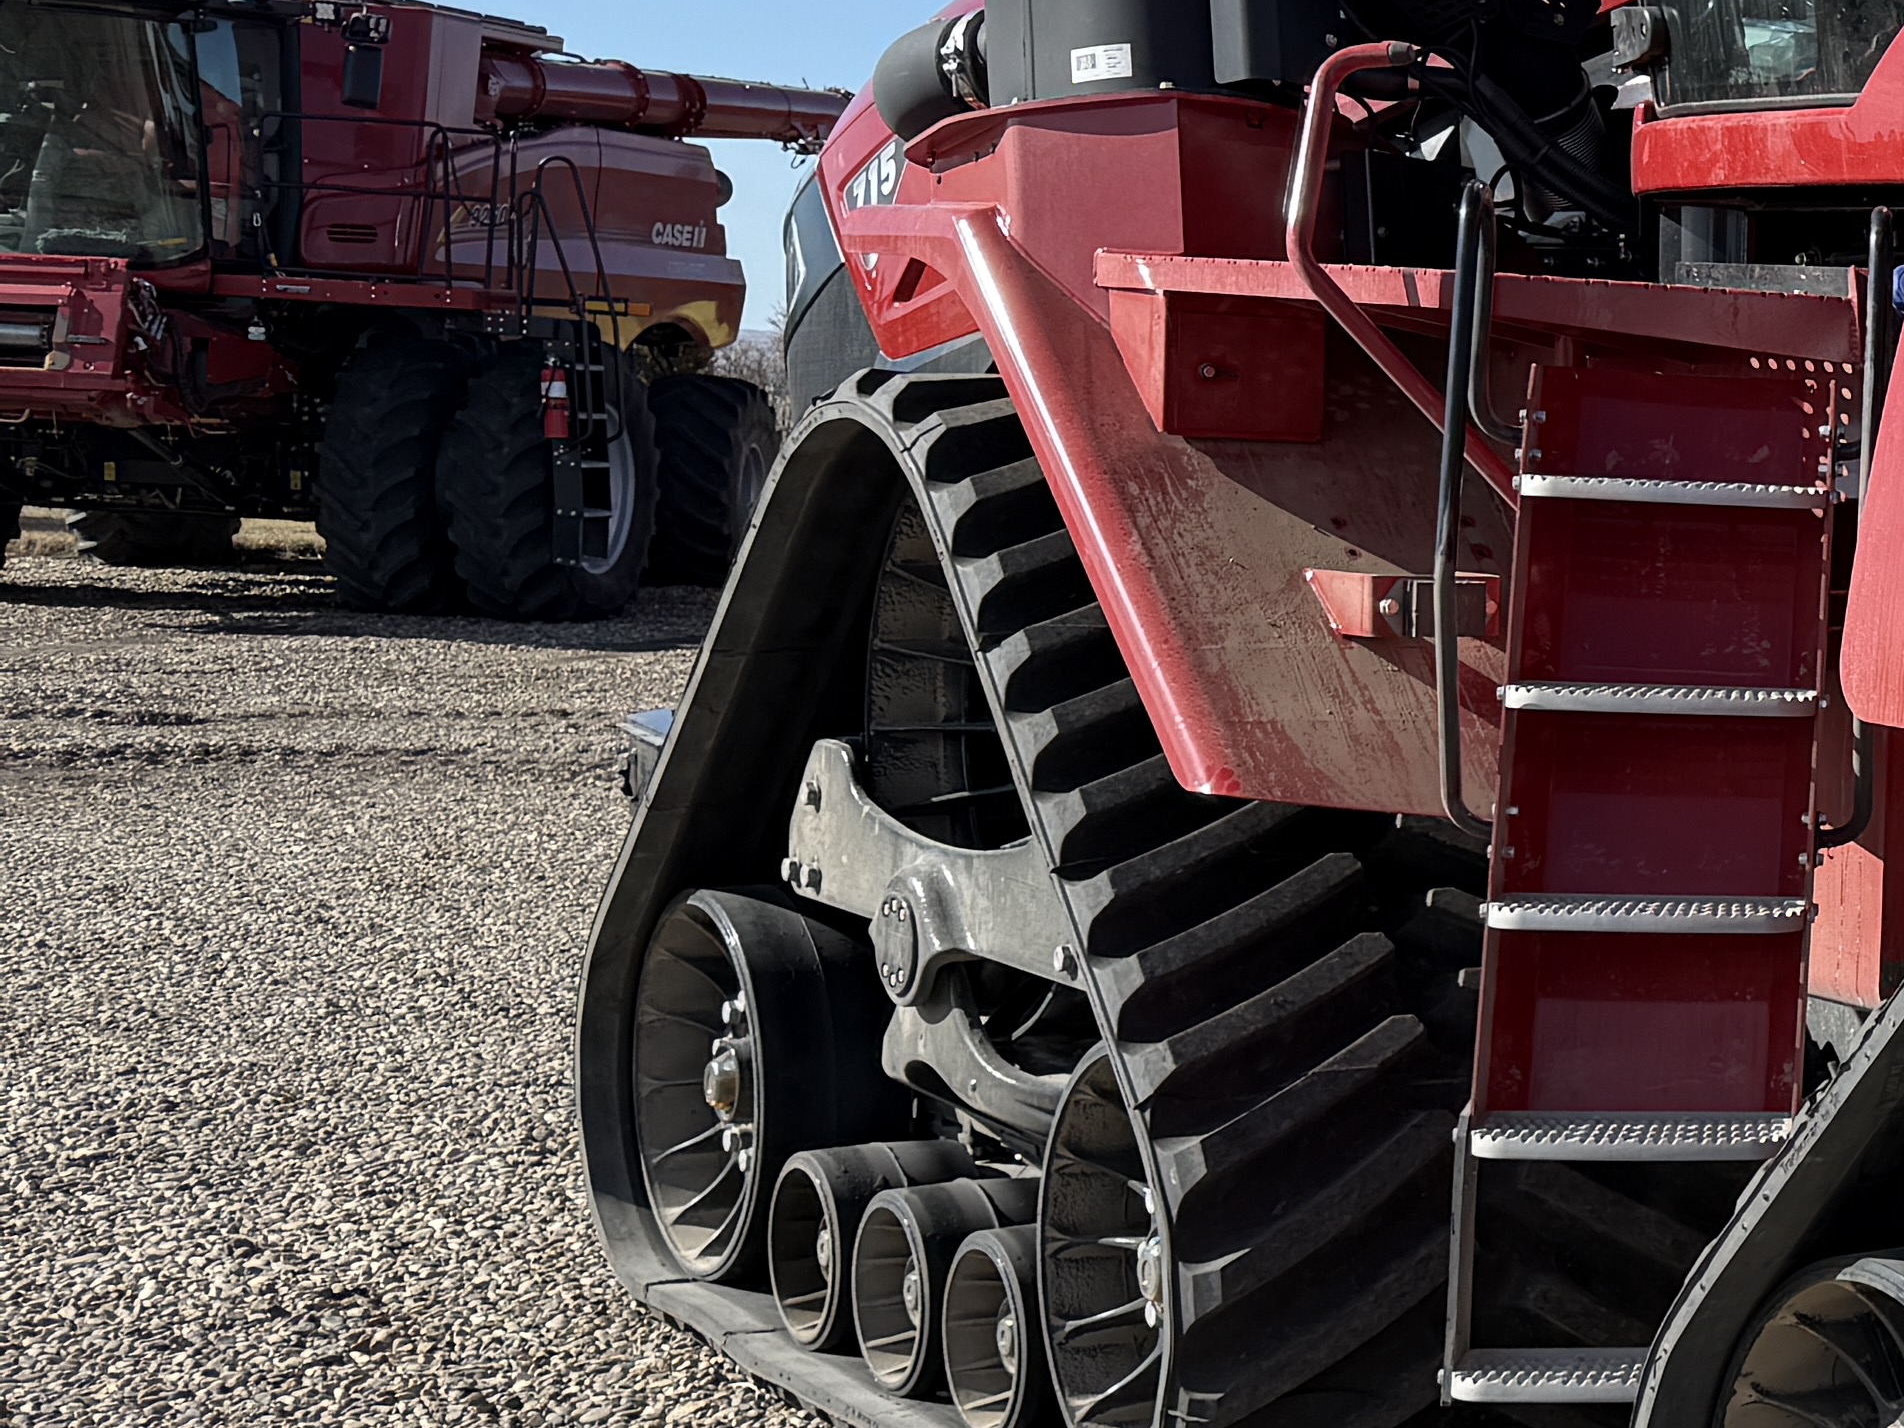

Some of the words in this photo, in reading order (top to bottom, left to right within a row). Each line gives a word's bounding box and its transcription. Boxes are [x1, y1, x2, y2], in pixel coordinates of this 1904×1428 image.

[852, 141, 896, 208] 715
[470, 203, 510, 226] 920
[651, 221, 693, 247] CASE
